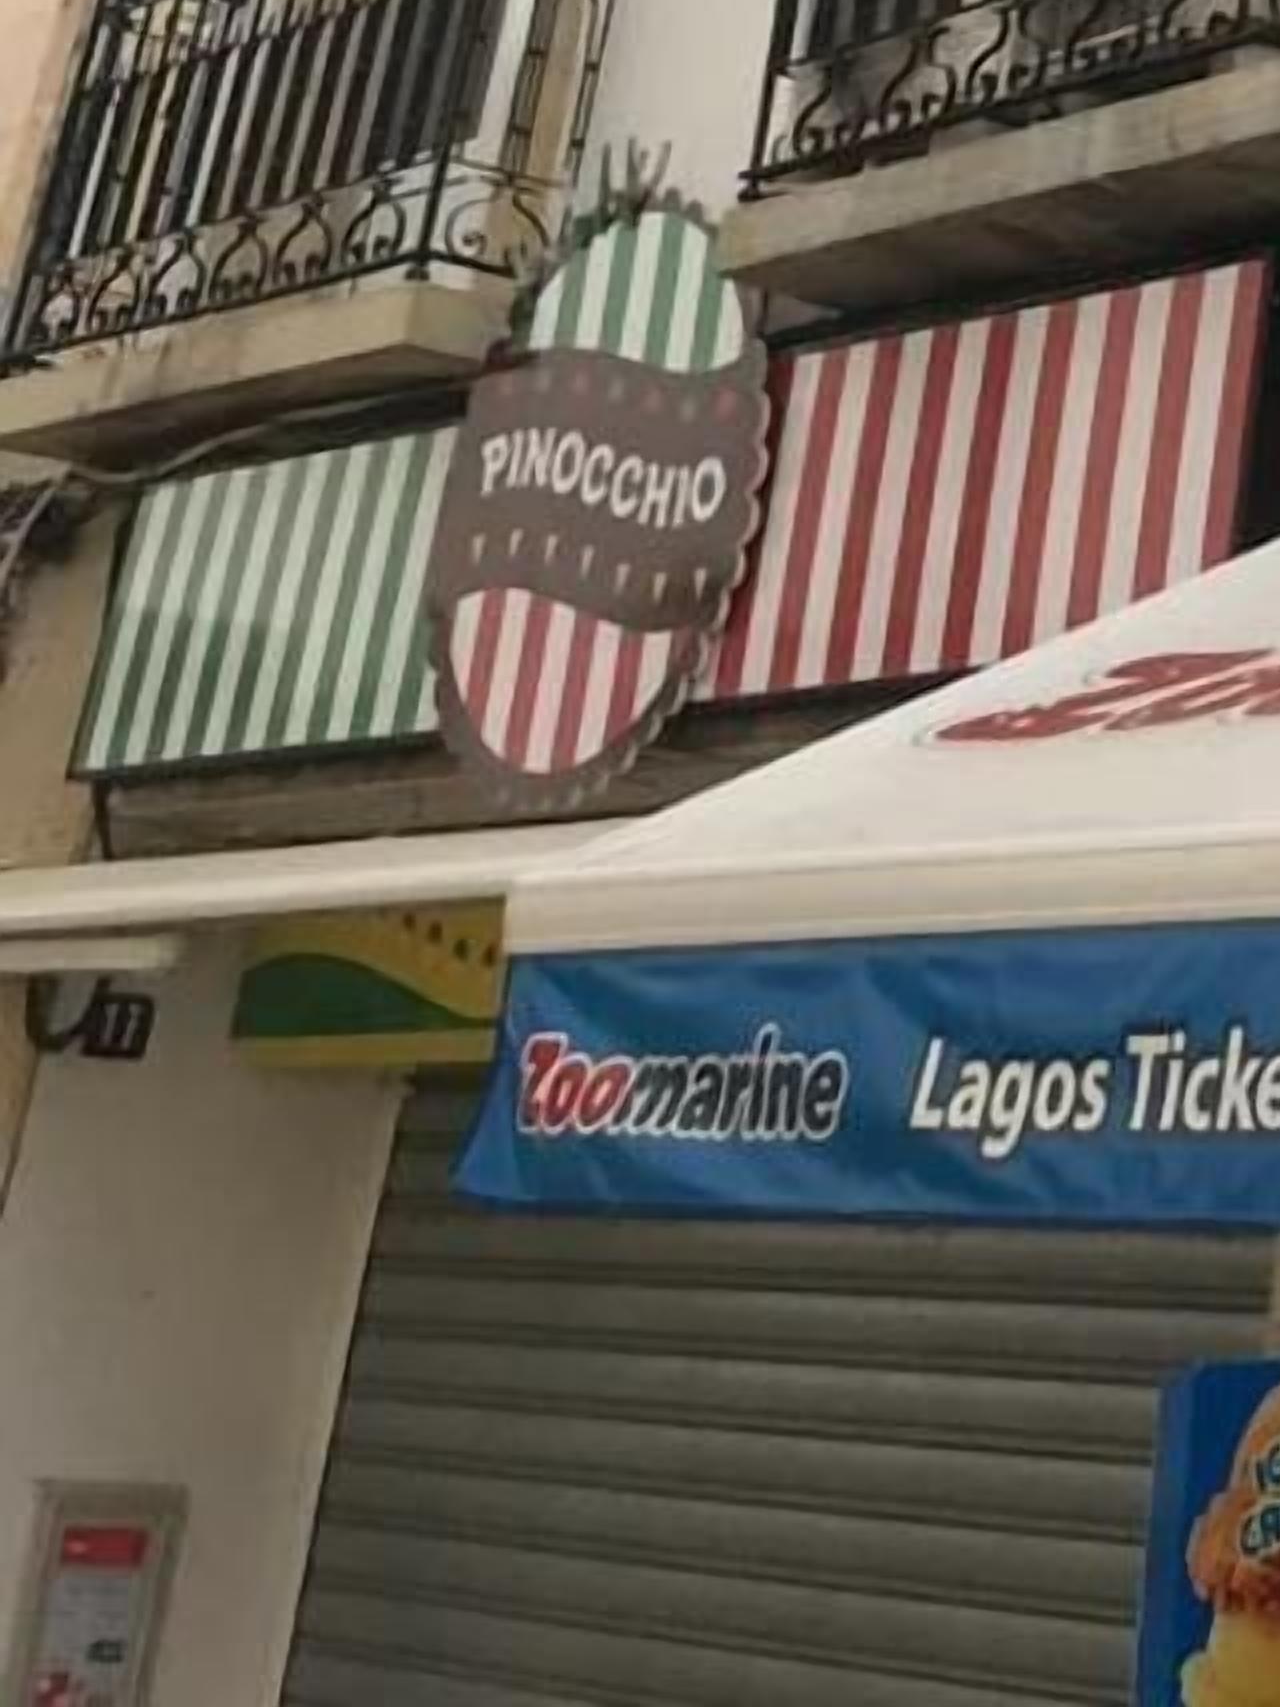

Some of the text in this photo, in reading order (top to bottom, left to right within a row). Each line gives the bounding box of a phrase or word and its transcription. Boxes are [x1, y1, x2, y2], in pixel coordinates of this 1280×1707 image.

[480, 426, 727, 529] PINOCCHIO
[518, 1023, 850, 1144] Zoomarine
[908, 1037, 1111, 1158] Lagos
